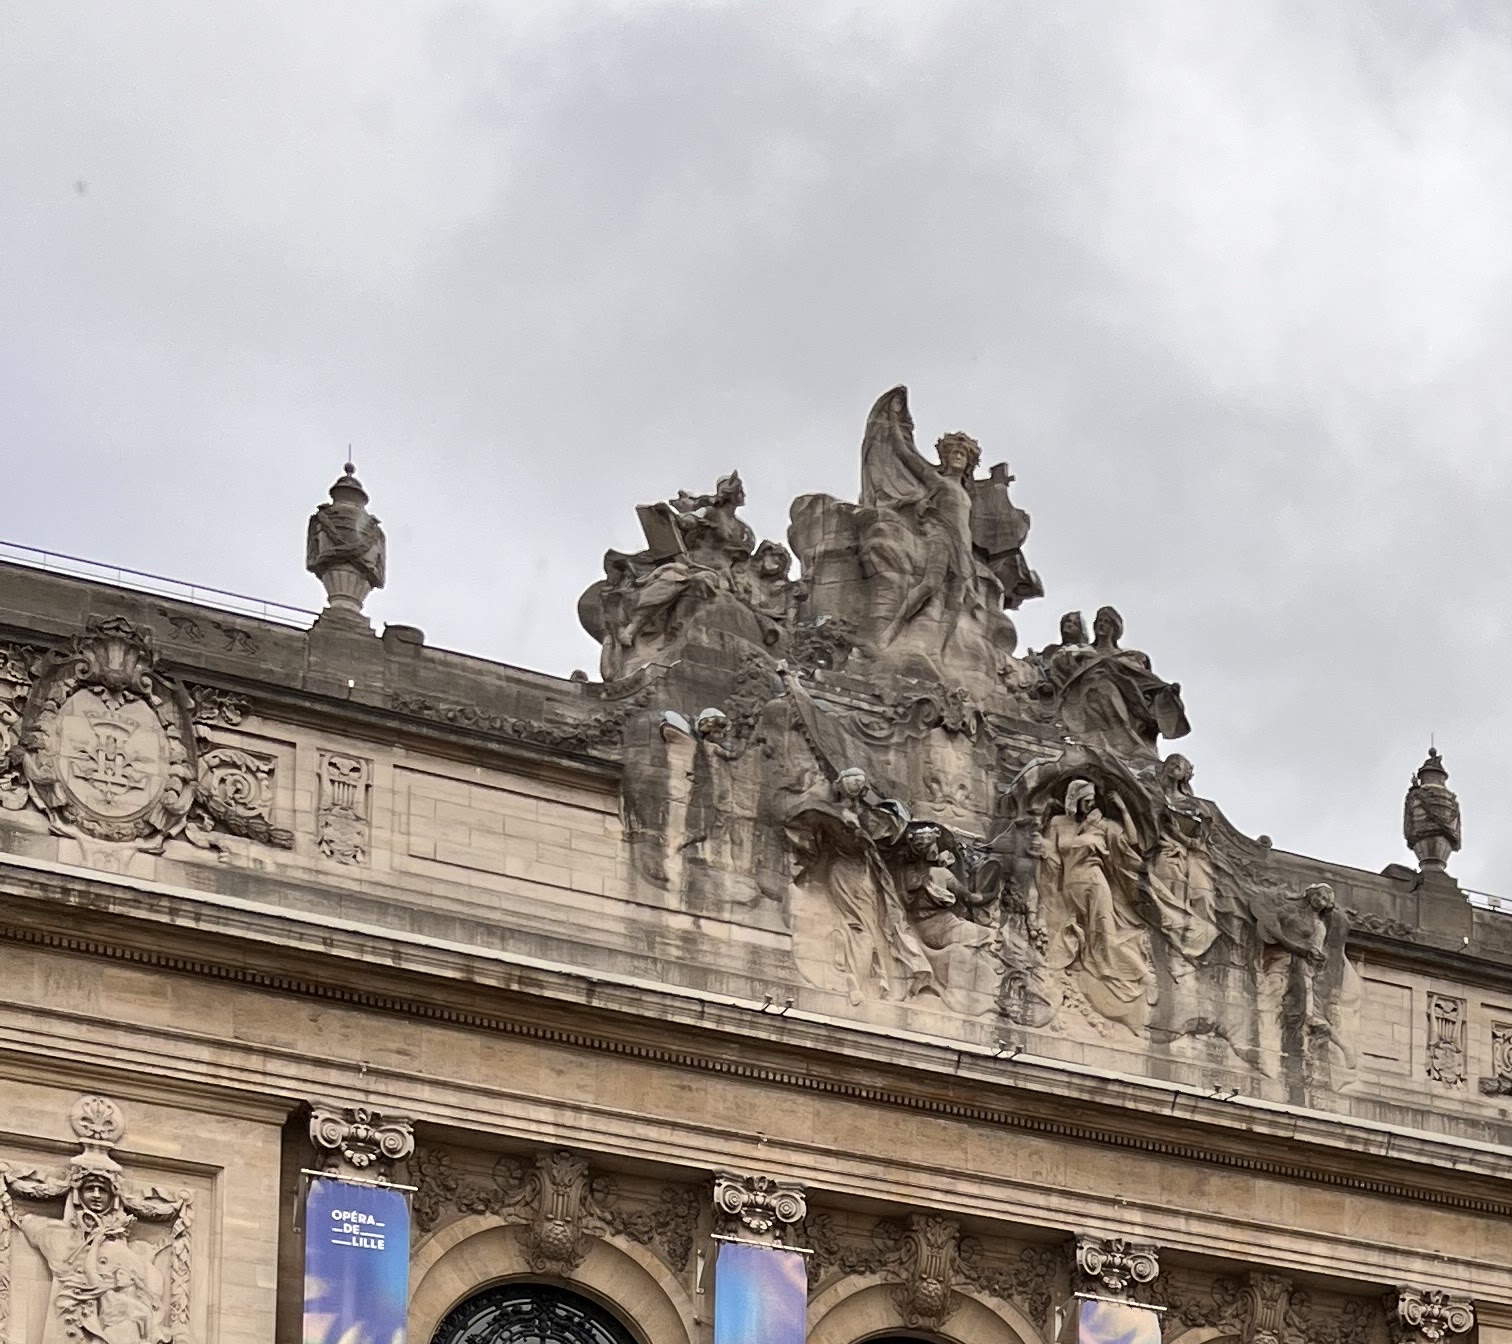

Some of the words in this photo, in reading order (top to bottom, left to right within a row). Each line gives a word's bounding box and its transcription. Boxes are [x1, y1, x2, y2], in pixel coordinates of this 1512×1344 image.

[331, 1209, 376, 1225] OPÉRA
[343, 1222, 360, 1235] DE
[351, 1236, 385, 1251] LILLE
